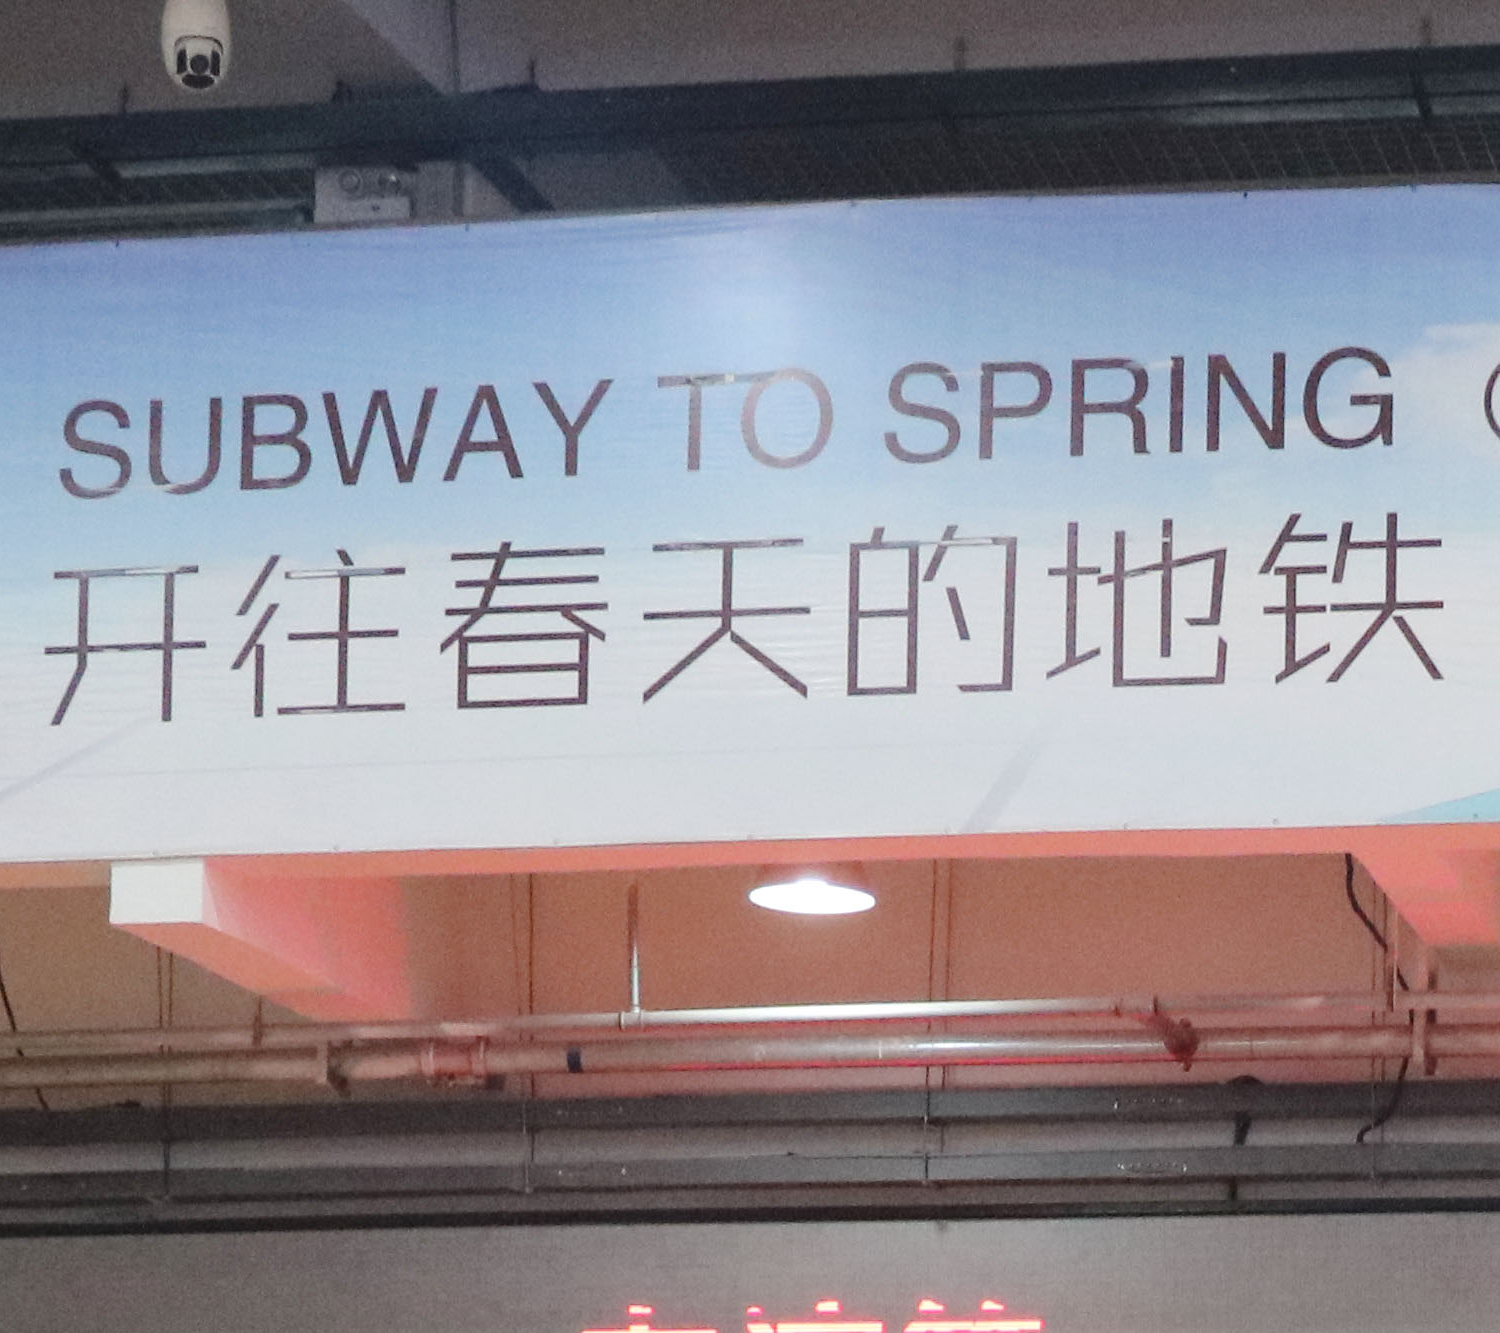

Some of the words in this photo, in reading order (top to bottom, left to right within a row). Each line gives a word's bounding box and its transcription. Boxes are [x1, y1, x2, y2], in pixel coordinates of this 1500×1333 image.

[59, 378, 613, 500] SUBWAY
[656, 367, 835, 472] TO
[884, 346, 1395, 464] SPRING
[43, 512, 1445, 727] 开往春天的地铁
